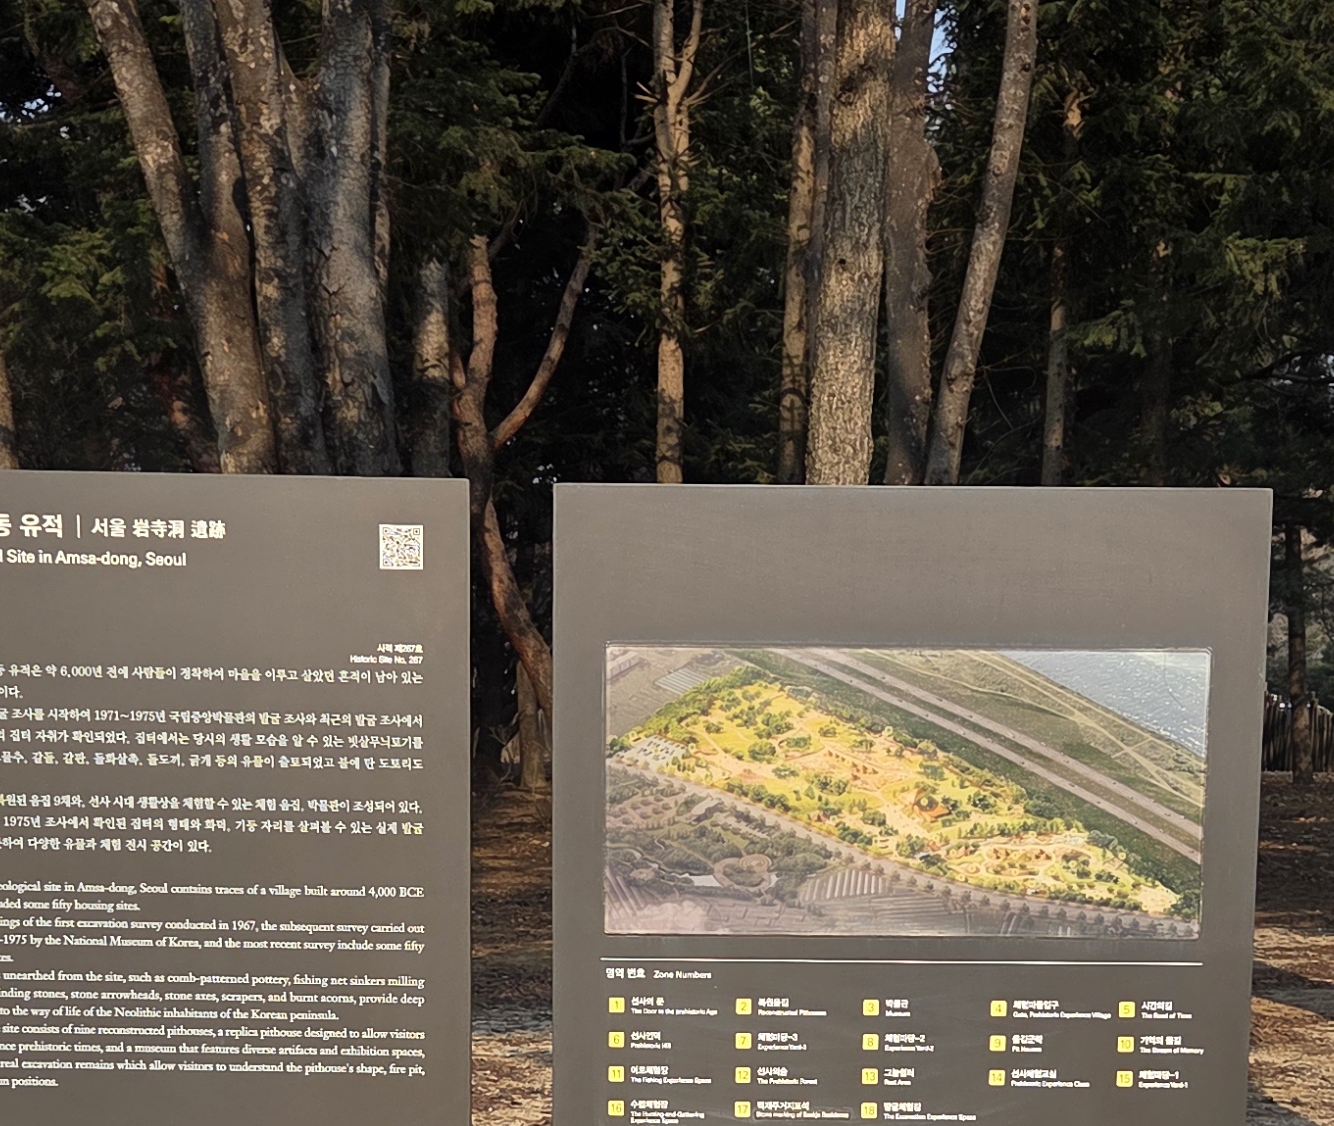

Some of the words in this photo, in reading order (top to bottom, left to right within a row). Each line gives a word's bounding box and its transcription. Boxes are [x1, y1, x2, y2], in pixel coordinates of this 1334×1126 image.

[18, 513, 63, 538] 유적
[90, 517, 126, 538] 서울
[5, 548, 35, 563] Site
[37, 549, 53, 564] in
[54, 549, 142, 569] Amsa-dong,
[144, 551, 186, 566] Seoul
[349, 654, 377, 663] Historic
[7, 663, 43, 677] 유적은
[44, 663, 57, 677] 약
[59, 664, 103, 678] 6,000년
[105, 664, 129, 679] 전에
[130, 665, 176, 680] 사람들이
[179, 666, 224, 681] 정착하여
[226, 667, 262, 681] 마을을
[264, 667, 299, 682] 이루고
[300, 668, 335, 683] 살았던
[337, 669, 371, 684] 흔적이
[374, 669, 398, 684] 남아
[400, 670, 423, 684] 있는
[10, 706, 45, 721] 조사를
[46, 707, 91, 722] 시작하여
[94, 709, 166, 723] 1971~1975년
[257, 711, 281, 725] 발굴
[282, 711, 317, 726] 조사와
[318, 712, 352, 726] 최근의
[354, 713, 377, 727] 발굴
[378, 713, 422, 728] 조사에서
[42, 880, 62, 891] site
[63, 881, 75, 892] in
[76, 881, 137, 895] Amsa-dong,
[138, 881, 168, 893] Seoul
[169, 883, 213, 894] contains
[214, 886, 244, 894] traces
[245, 883, 259, 895] of
[259, 886, 267, 895] a
[267, 883, 302, 898] village
[303, 884, 328, 896] built
[329, 885, 366, 896] around
[367, 886, 396, 899] 4,000
[398, 885, 424, 897] BCE
[22, 900, 50, 909] some
[51, 898, 73, 913] fifty
[73, 898, 114, 913] housing
[115, 899, 140, 911] sites.
[627, 968, 646, 979] 번호
[653, 970, 674, 979] Zone
[675, 970, 712, 979] Numbers
[10, 1075, 59, 1089] positions.
